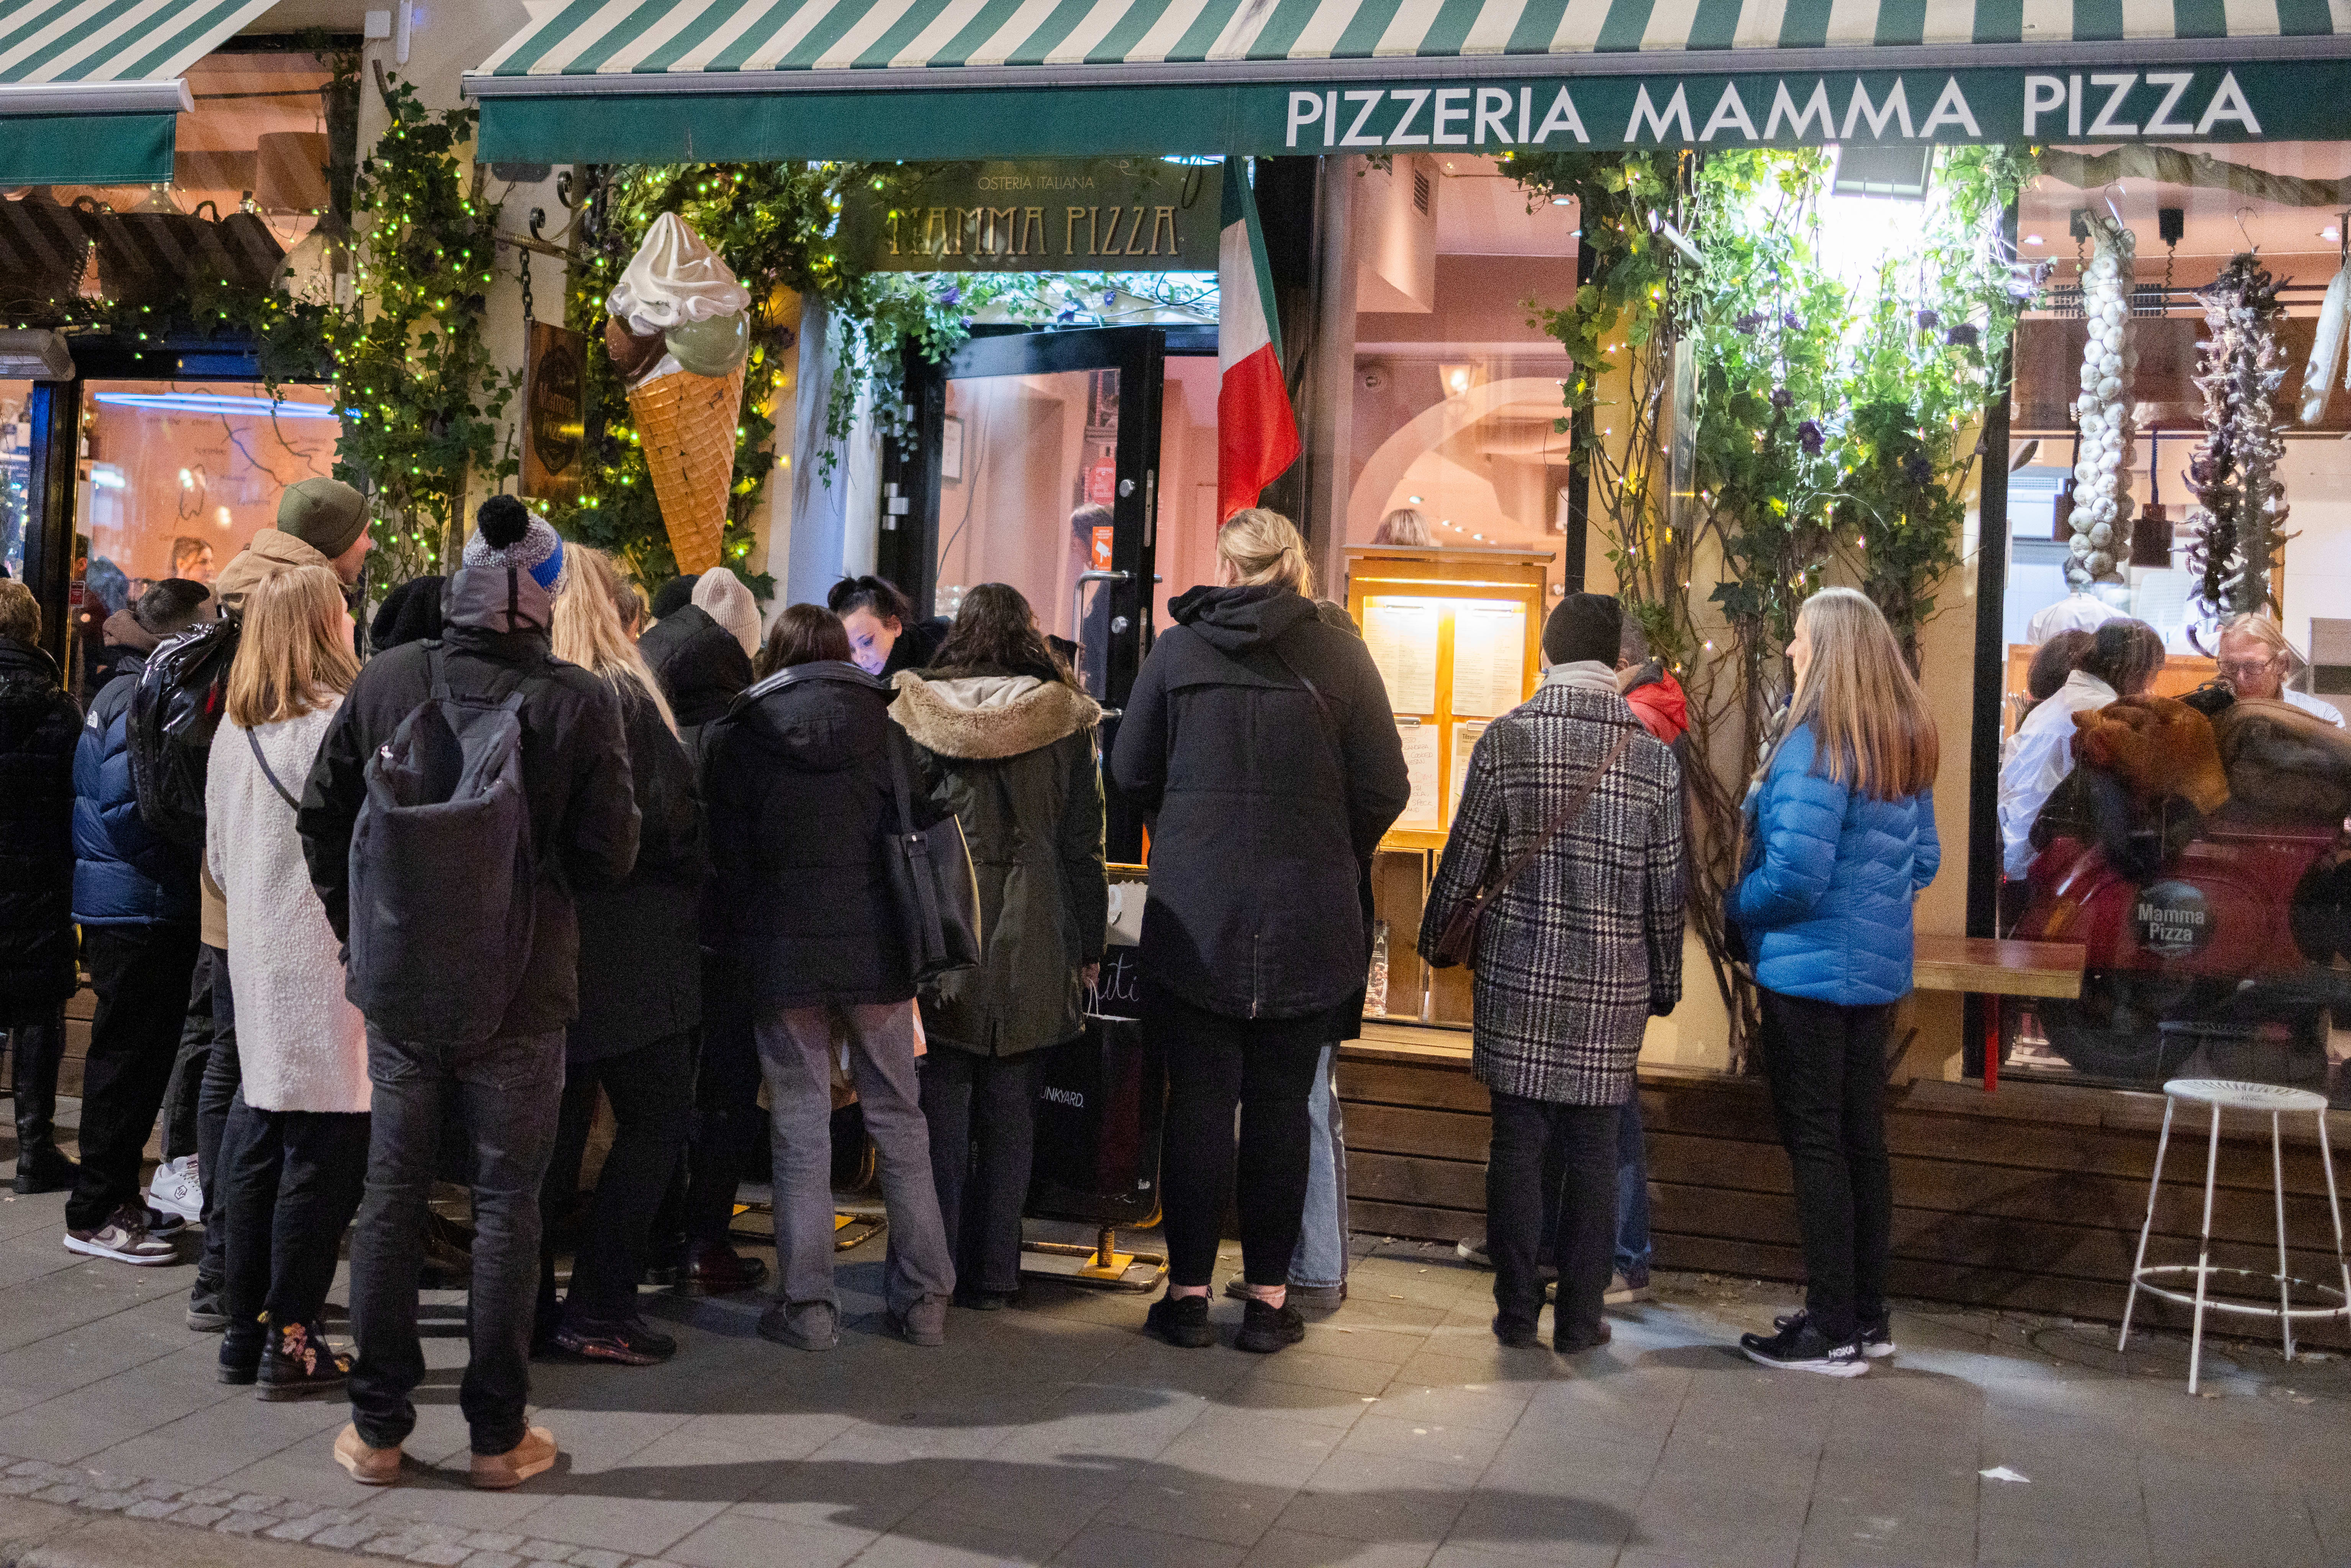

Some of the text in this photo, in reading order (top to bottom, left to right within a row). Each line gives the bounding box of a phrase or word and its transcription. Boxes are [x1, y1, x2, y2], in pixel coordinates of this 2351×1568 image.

[1286, 70, 2262, 147] PIZZERIA MAMMA PIZZA
[978, 176, 1095, 190] OSTERIA ITALIANA
[1064, 206, 1178, 255] PIZZA
[2138, 903, 2204, 925] Mamma
[2149, 922, 2193, 942] Pizza
[1040, 1086, 1084, 1108] UNKYARD.
[1828, 1345, 1855, 1358] HOKA
